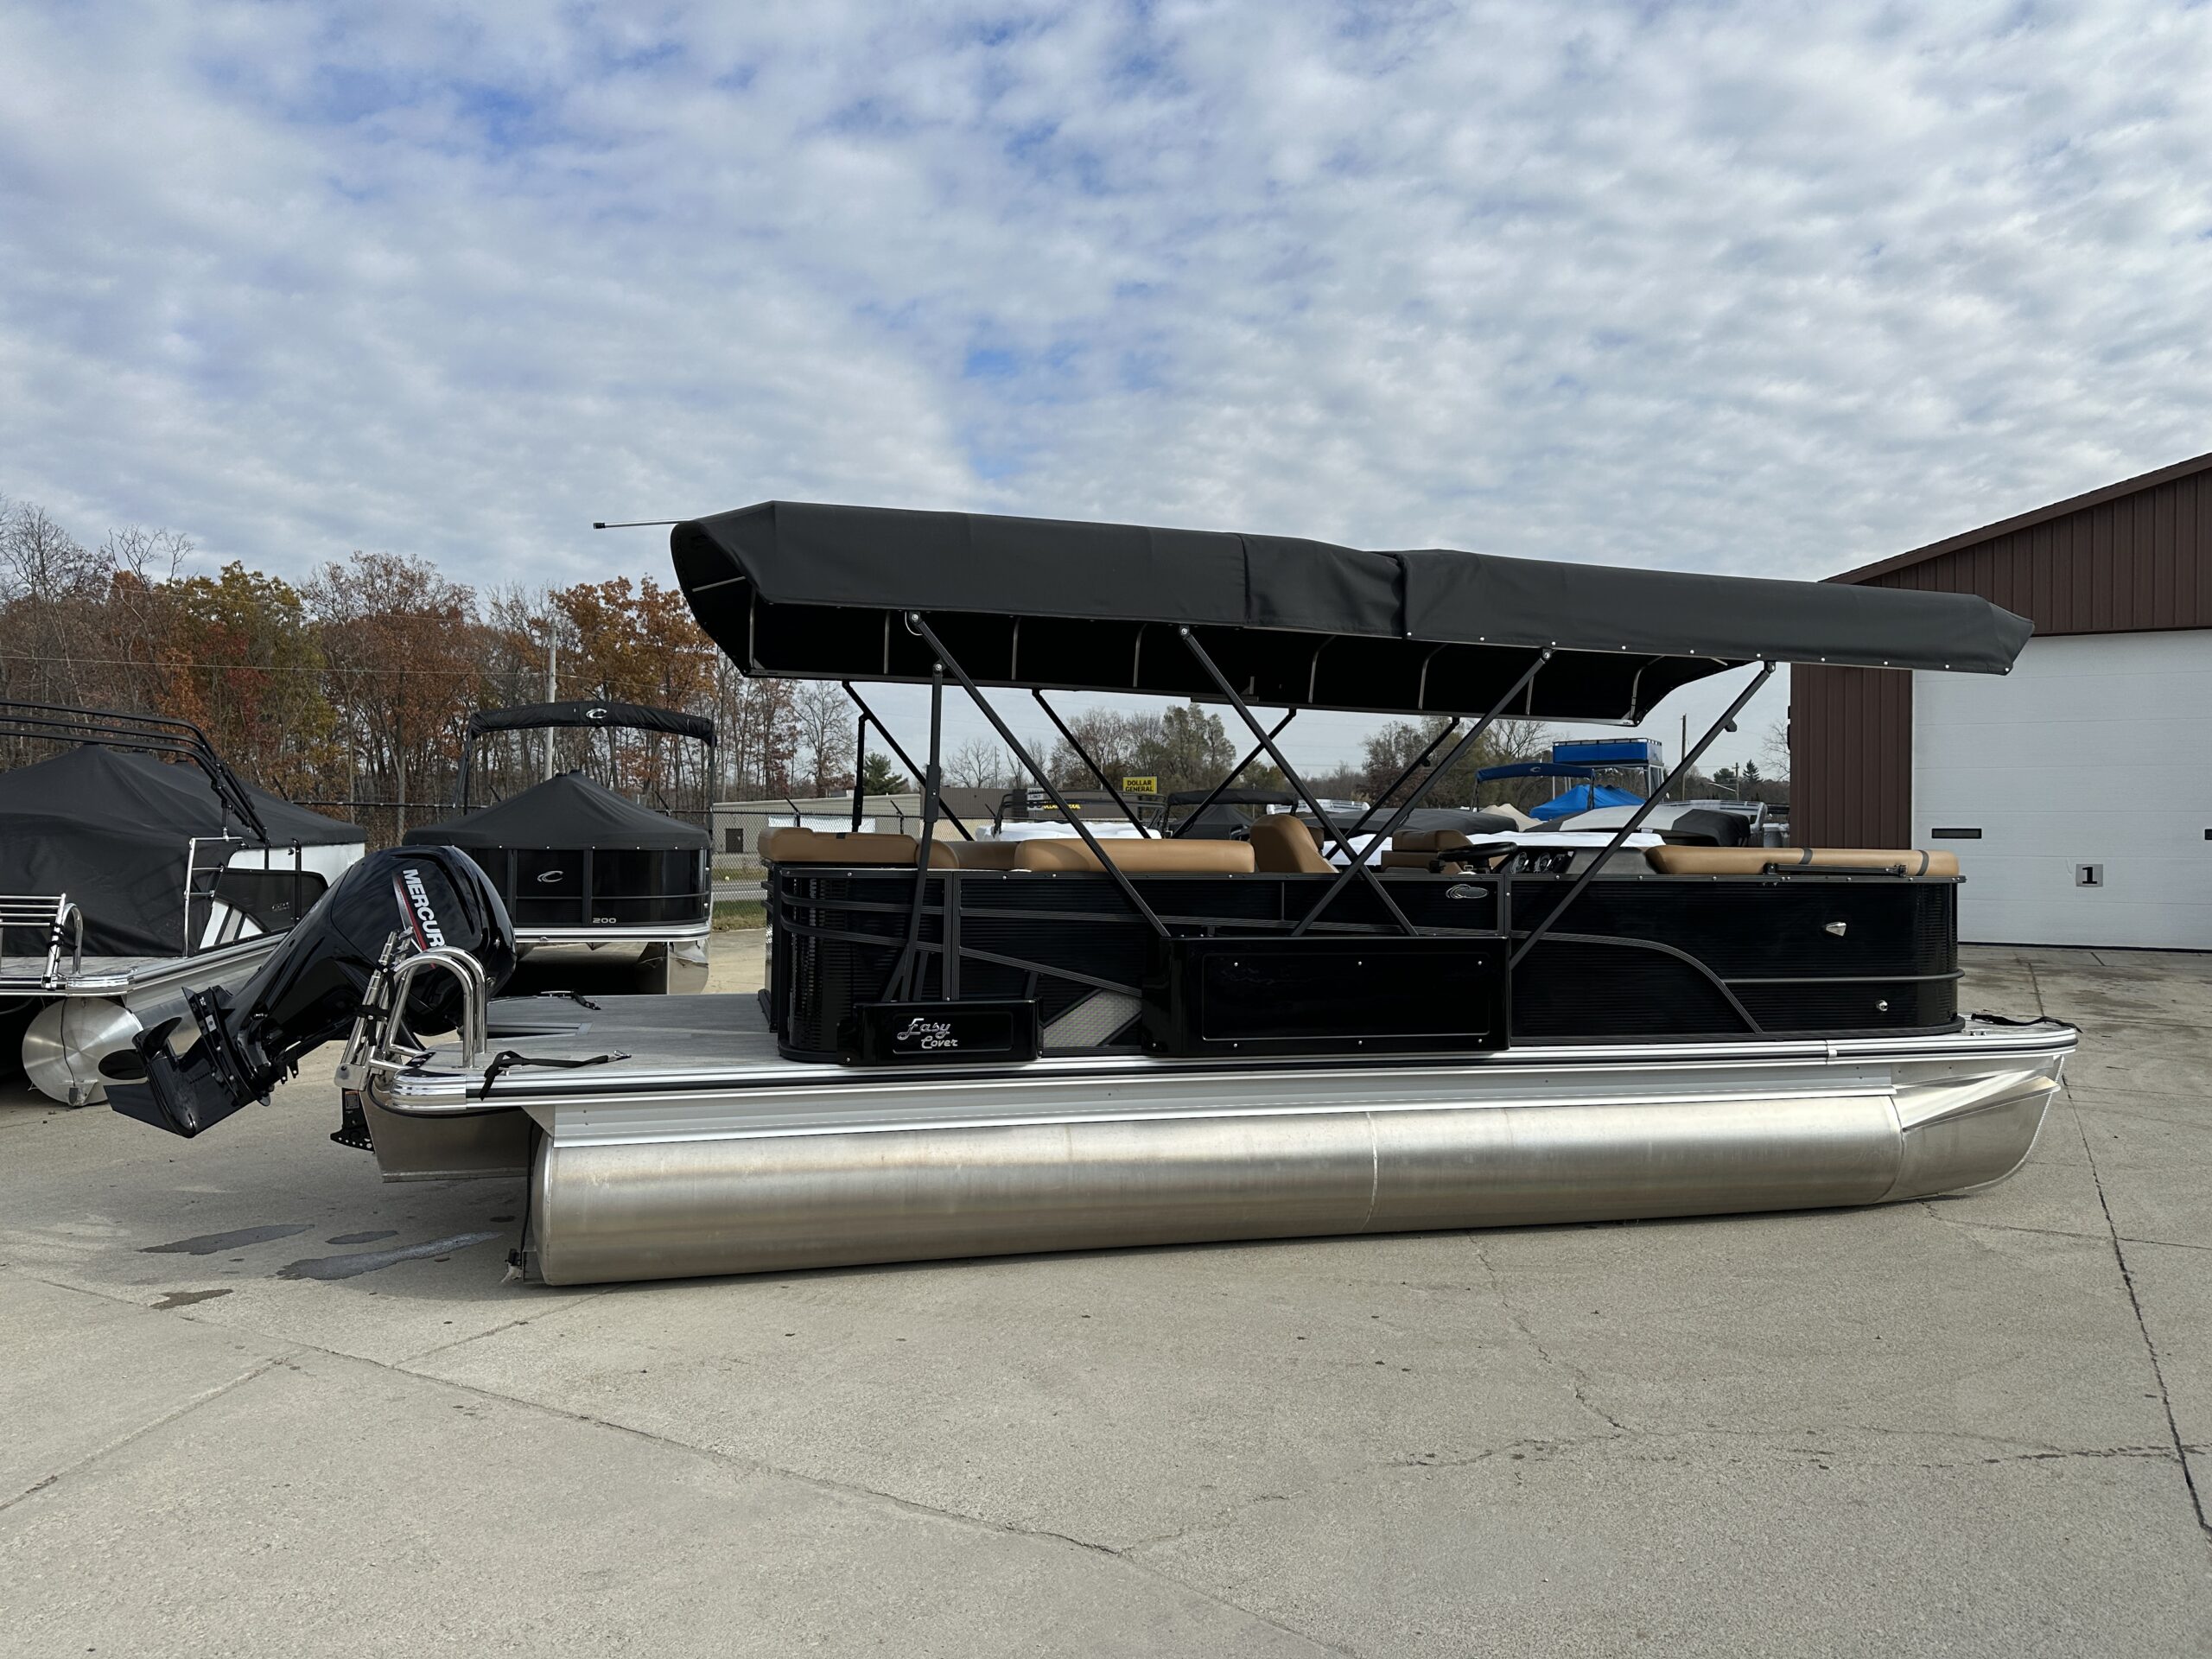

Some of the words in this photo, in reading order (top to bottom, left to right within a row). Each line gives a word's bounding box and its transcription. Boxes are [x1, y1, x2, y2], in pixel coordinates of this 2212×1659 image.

[2082, 866, 2098, 885] 1
[403, 868, 446, 947] MERCUR
[897, 1018, 951, 1040] Easy
[921, 1035, 958, 1050] Cover
